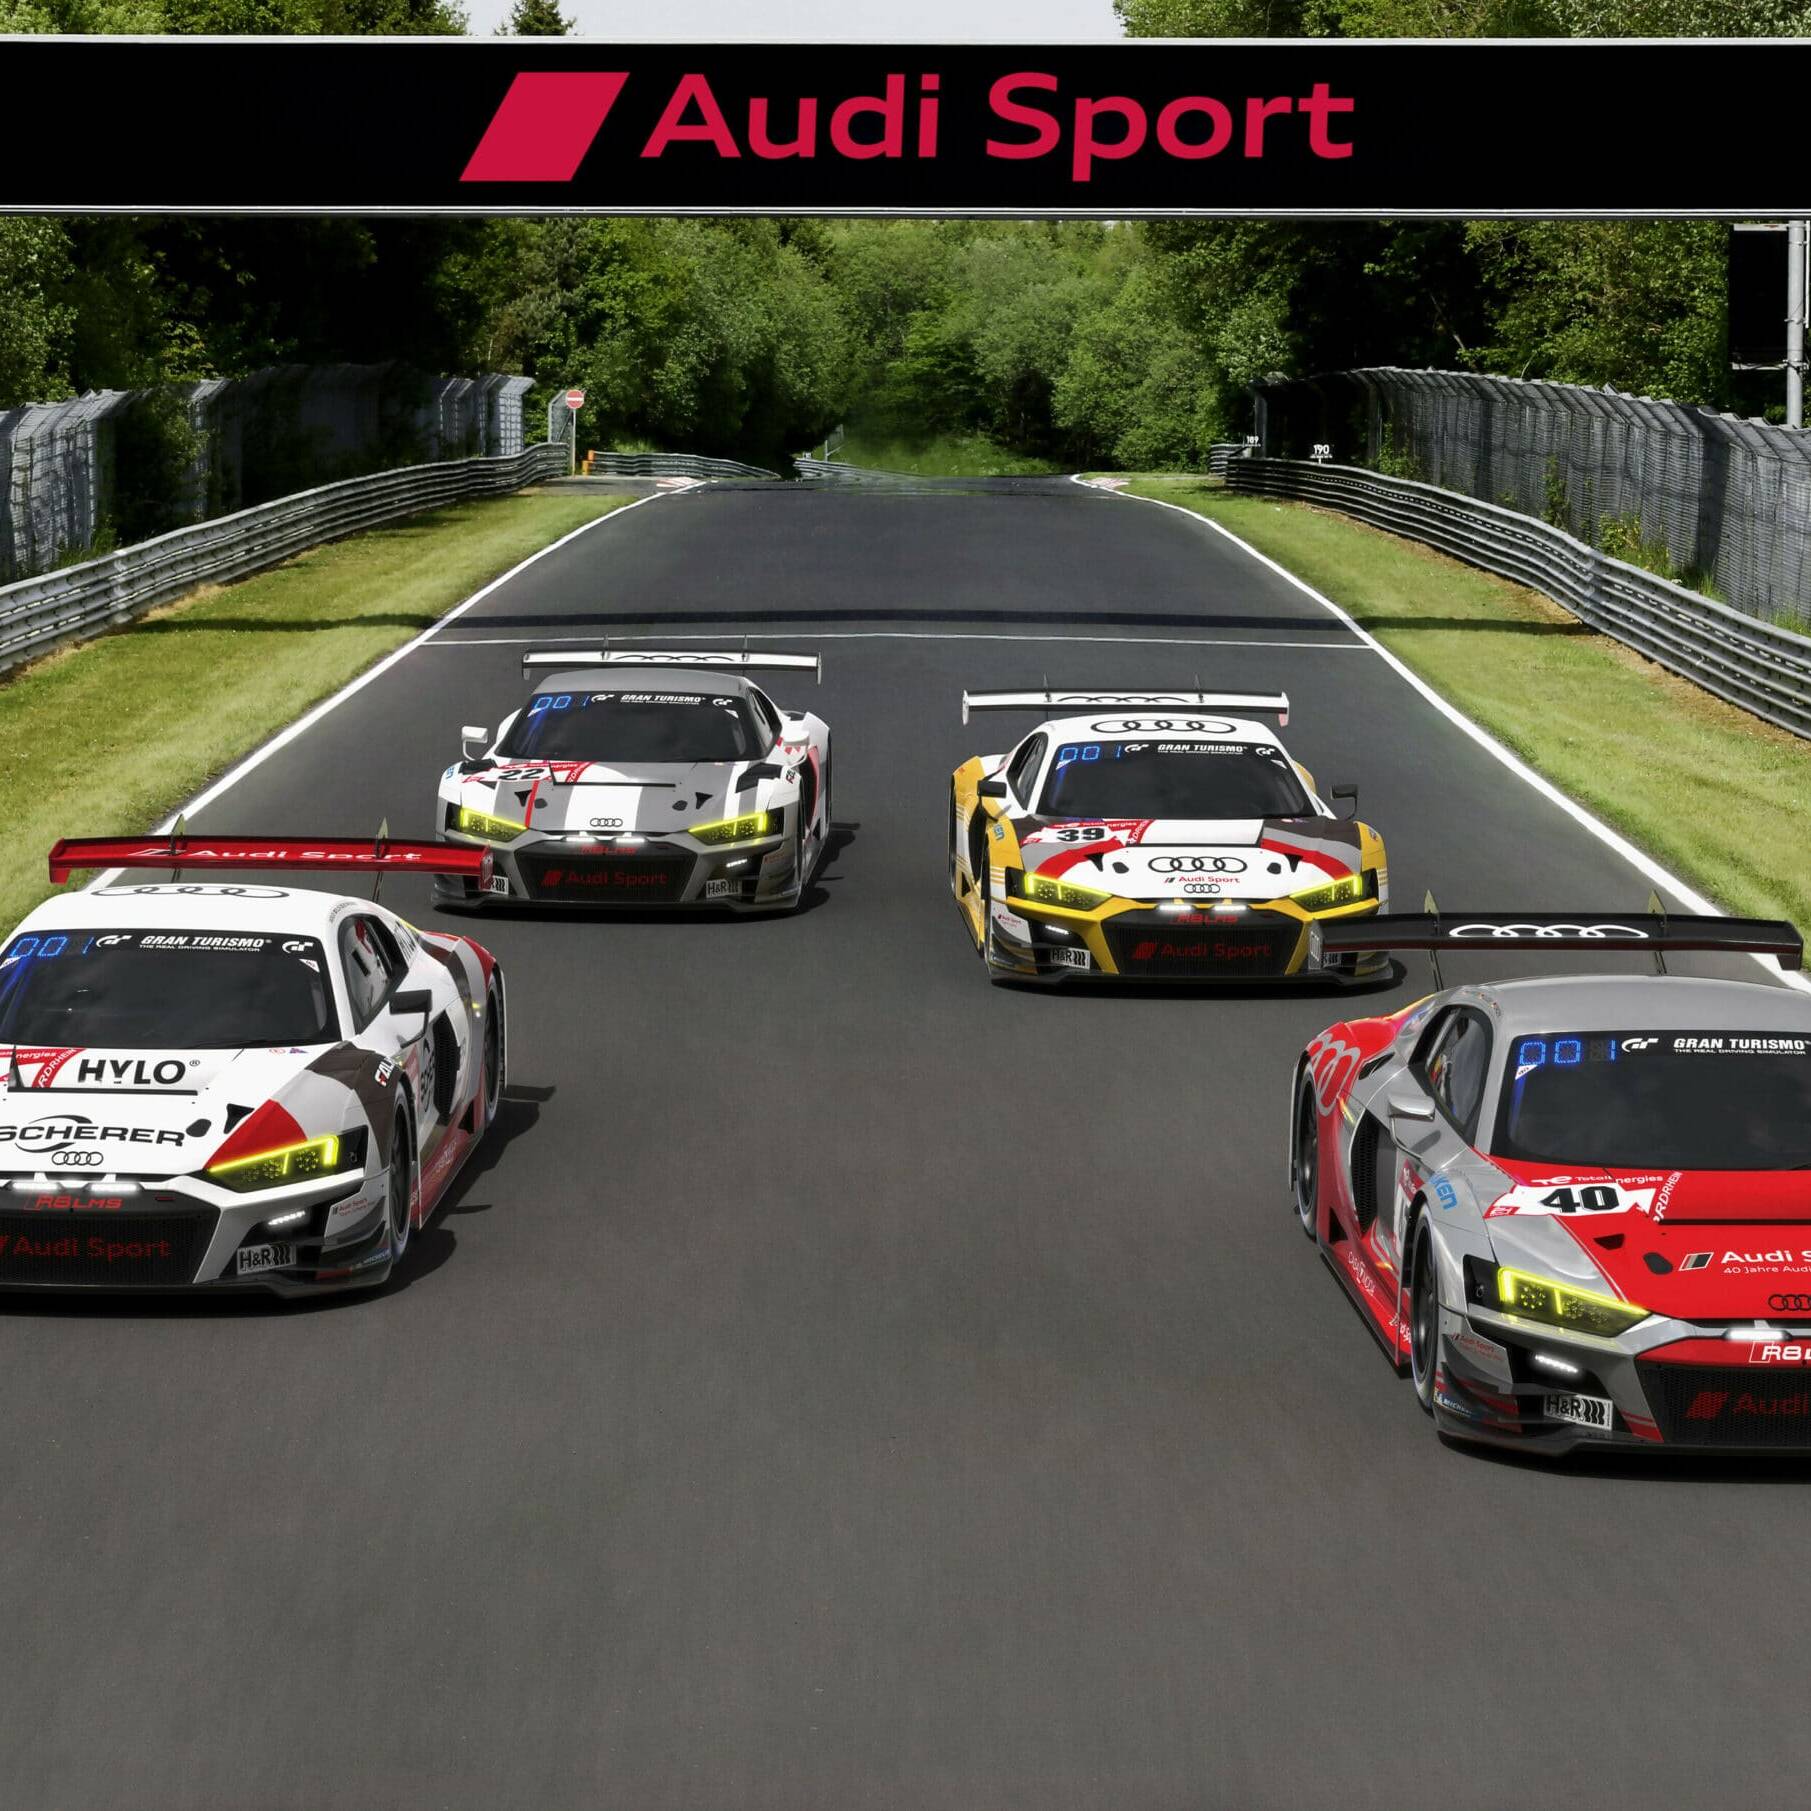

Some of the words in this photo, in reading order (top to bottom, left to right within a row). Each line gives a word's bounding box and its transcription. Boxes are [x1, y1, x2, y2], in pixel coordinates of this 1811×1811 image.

[640, 73, 941, 159] Audi
[986, 71, 1355, 182] Sport
[1313, 445, 1329, 454] 190
[654, 695, 701, 703] TURISMO
[1193, 744, 1244, 753] TURISMO
[498, 768, 545, 780] 22
[1056, 827, 1105, 842] 39
[191, 850, 287, 858] Audi
[300, 851, 421, 859] Sport
[566, 871, 608, 885] Audi
[614, 871, 668, 888] Sport
[1208, 876, 1240, 884] Sport
[141, 936, 188, 945] GRAN
[192, 936, 265, 948] TURISMO
[1161, 943, 1208, 957] Audi
[1216, 943, 1272, 960] Sport
[1673, 1038, 1723, 1049] GRAN
[1729, 1039, 1805, 1050] TURISMO
[0, 1126, 185, 1147] SCHERER
[1539, 1186, 1620, 1213] 40
[13, 1236, 79, 1257] Audi
[88, 1237, 171, 1263] Sport
[239, 1246, 272, 1273] H&R
[1721, 1251, 1793, 1264] Audi
[1744, 1266, 1779, 1274] Jahre
[1761, 1345, 1801, 1361] R8
[1546, 1396, 1582, 1418] H&R
[1732, 1391, 1809, 1415] Audi
